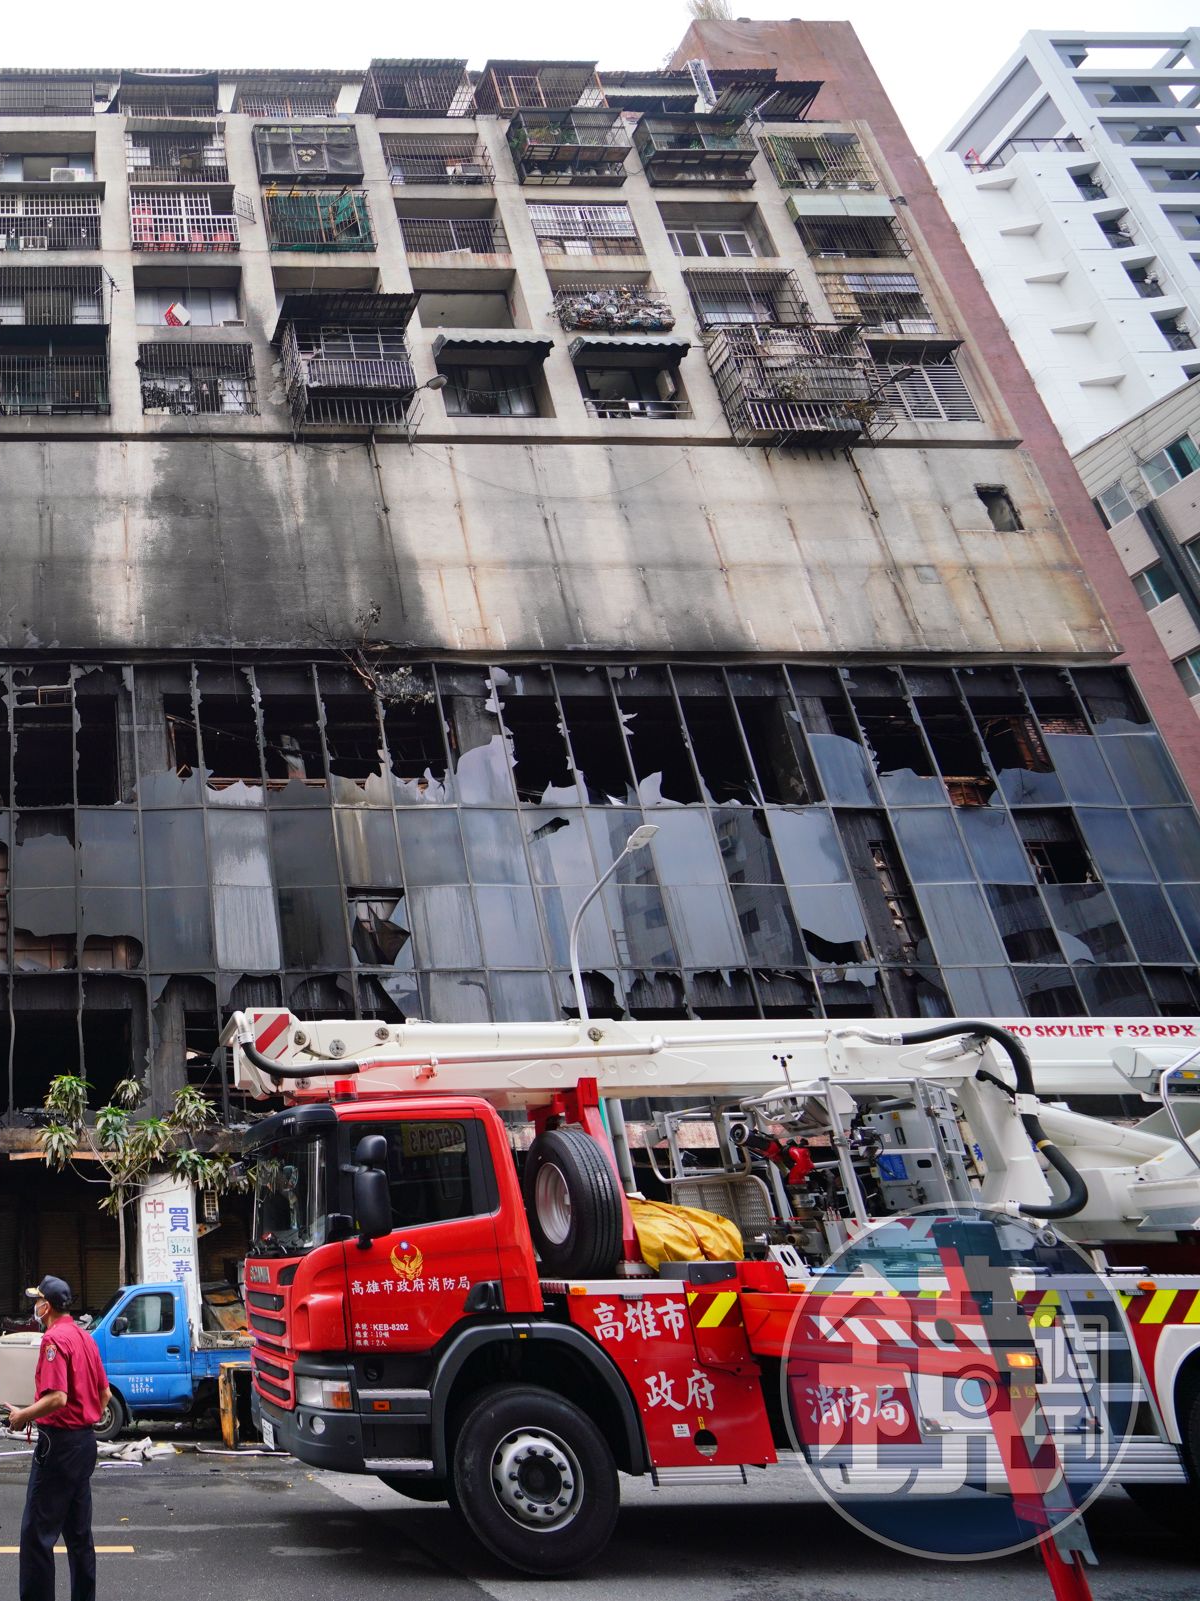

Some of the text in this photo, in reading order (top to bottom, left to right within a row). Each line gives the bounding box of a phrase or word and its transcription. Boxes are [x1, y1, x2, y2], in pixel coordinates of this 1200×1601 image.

[1003, 1025, 1196, 1037] TO SKYLIFT F 32 RPX
[171, 1244, 191, 1254] 31-24
[351, 1276, 471, 1295] 高雄市政府消防局
[593, 1298, 686, 1341] 高雄市
[644, 1369, 715, 1411] 政府
[806, 1385, 905, 1427] 消防局
